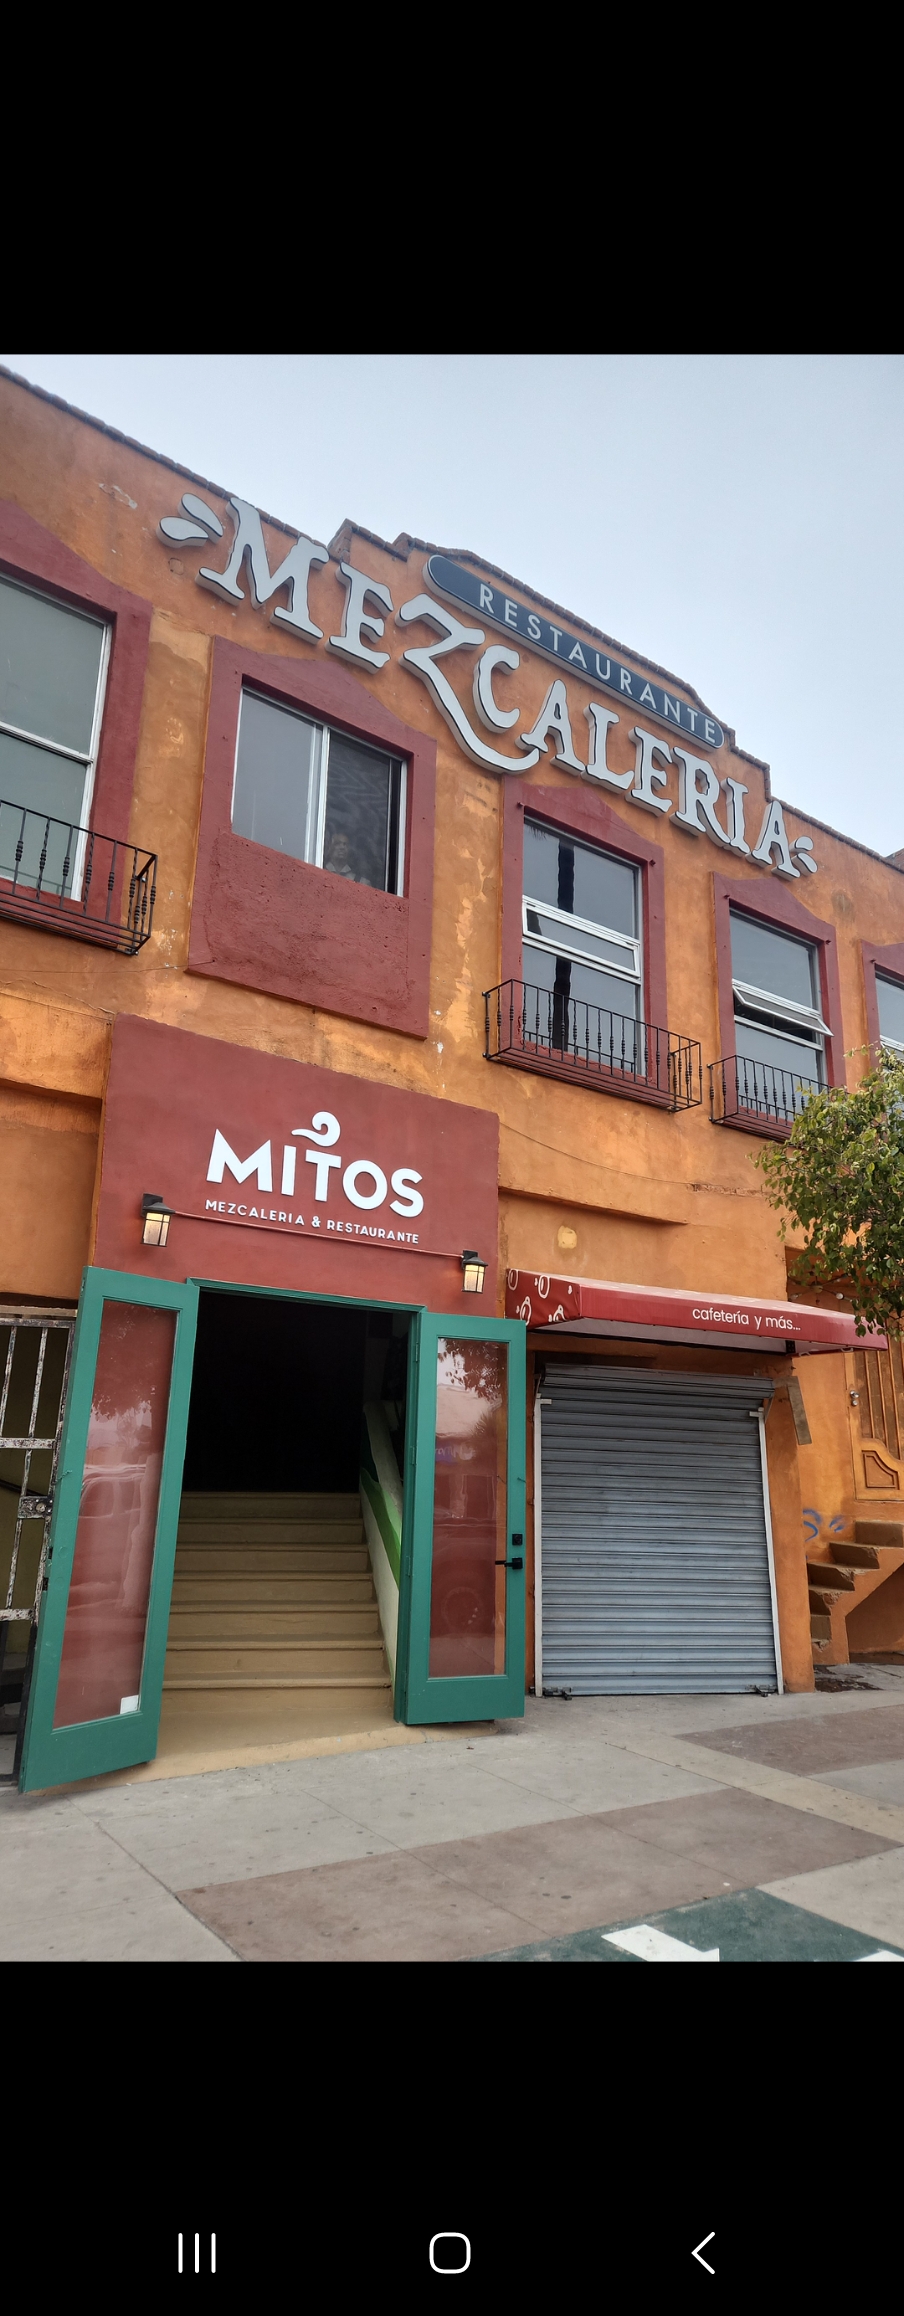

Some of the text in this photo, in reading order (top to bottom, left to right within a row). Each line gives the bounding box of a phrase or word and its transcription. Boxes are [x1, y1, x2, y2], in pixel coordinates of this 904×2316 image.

[195, 496, 798, 881] MEZCALERIA
[479, 582, 718, 745] RESTAURANTE
[206, 1128, 425, 1218] MITOS
[205, 1199, 420, 1245] MEZCALERIA & RESTAURANTE
[692, 1307, 801, 1331] cafetería y más...
